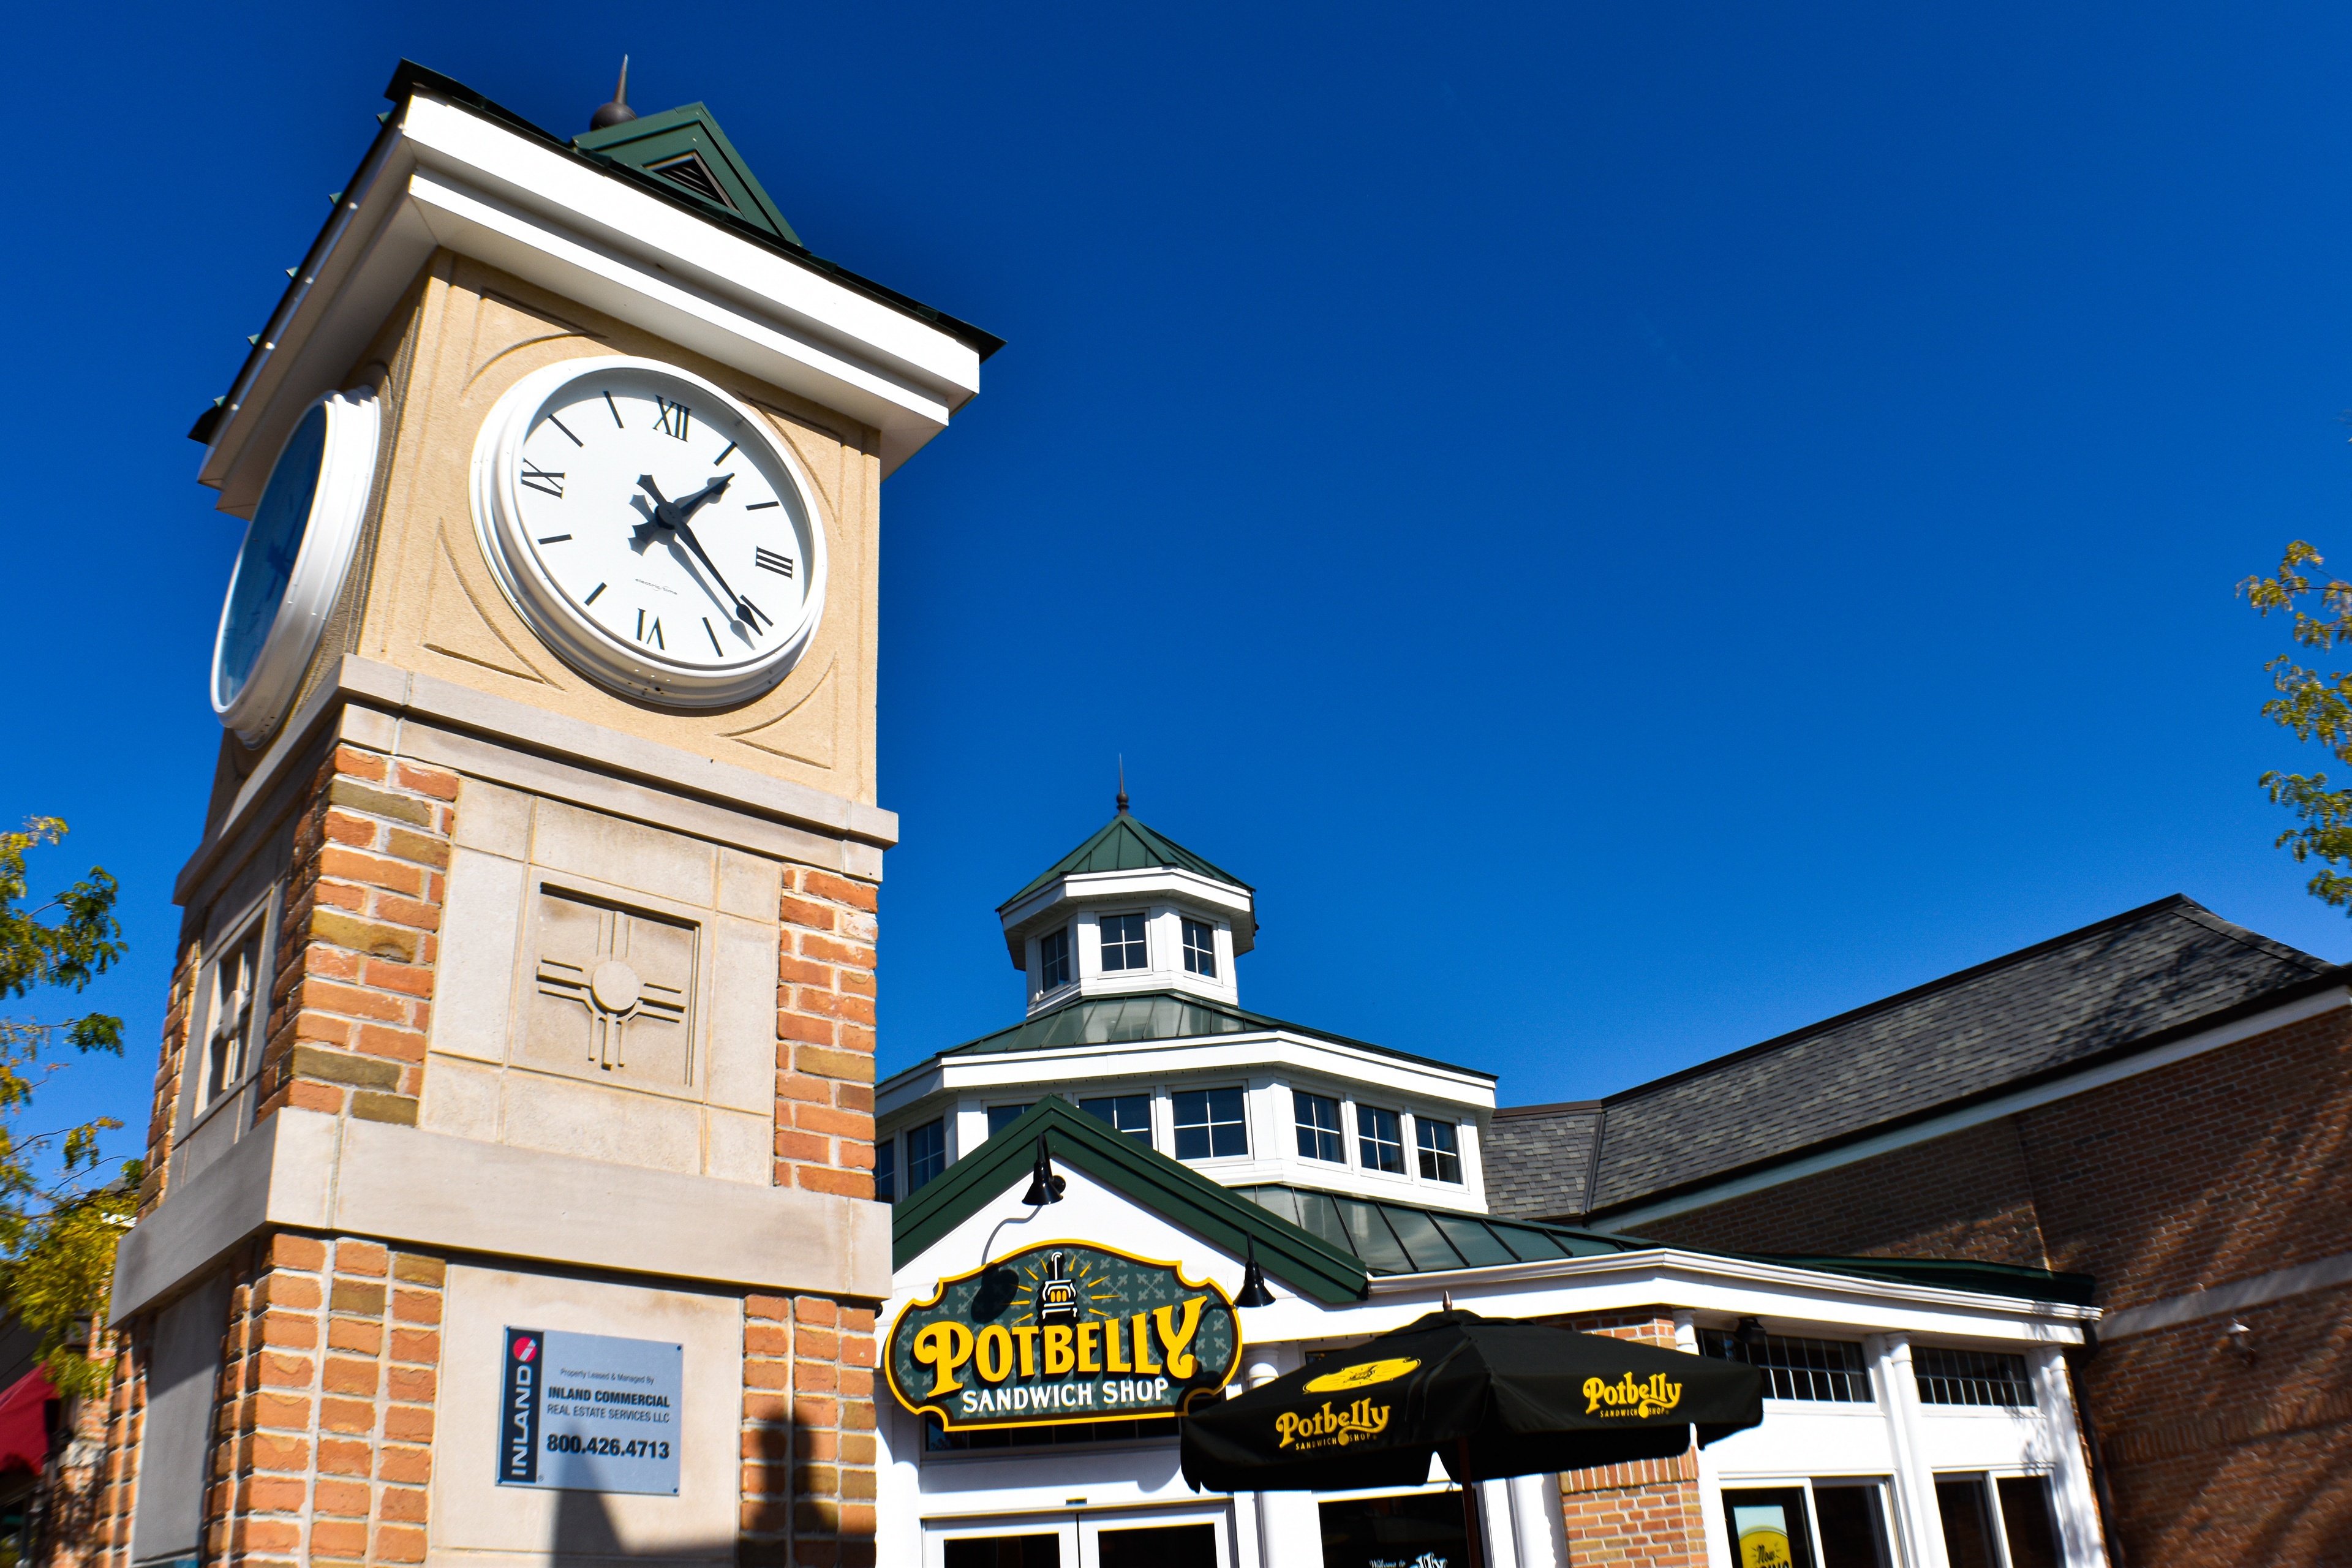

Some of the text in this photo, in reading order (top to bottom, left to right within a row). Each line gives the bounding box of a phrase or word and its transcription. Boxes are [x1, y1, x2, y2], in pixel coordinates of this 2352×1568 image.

[653, 394, 692, 442] XII
[755, 545, 793, 579] III
[913, 1295, 1208, 1398] POTBELLY
[560, 1367, 586, 1379] Property
[587, 1371, 610, 1381] Leased
[617, 1373, 645, 1385] Managed
[646, 1376, 655, 1385] By
[548, 1385, 671, 1408] INLAND COMMERCIAL
[962, 1378, 1169, 1414] SANDWICH SHOP
[1583, 1372, 1683, 1419] Potbelly
[511, 1365, 532, 1476] INLAND
[547, 1403, 670, 1423] REAL ESTATE SERVICES LLC
[1275, 1397, 1391, 1449] Potbelly
[1600, 1409, 1638, 1418] SANDWICH
[547, 1434, 670, 1459] 800.426.4713
[1295, 1437, 1336, 1450] SANDWICH
